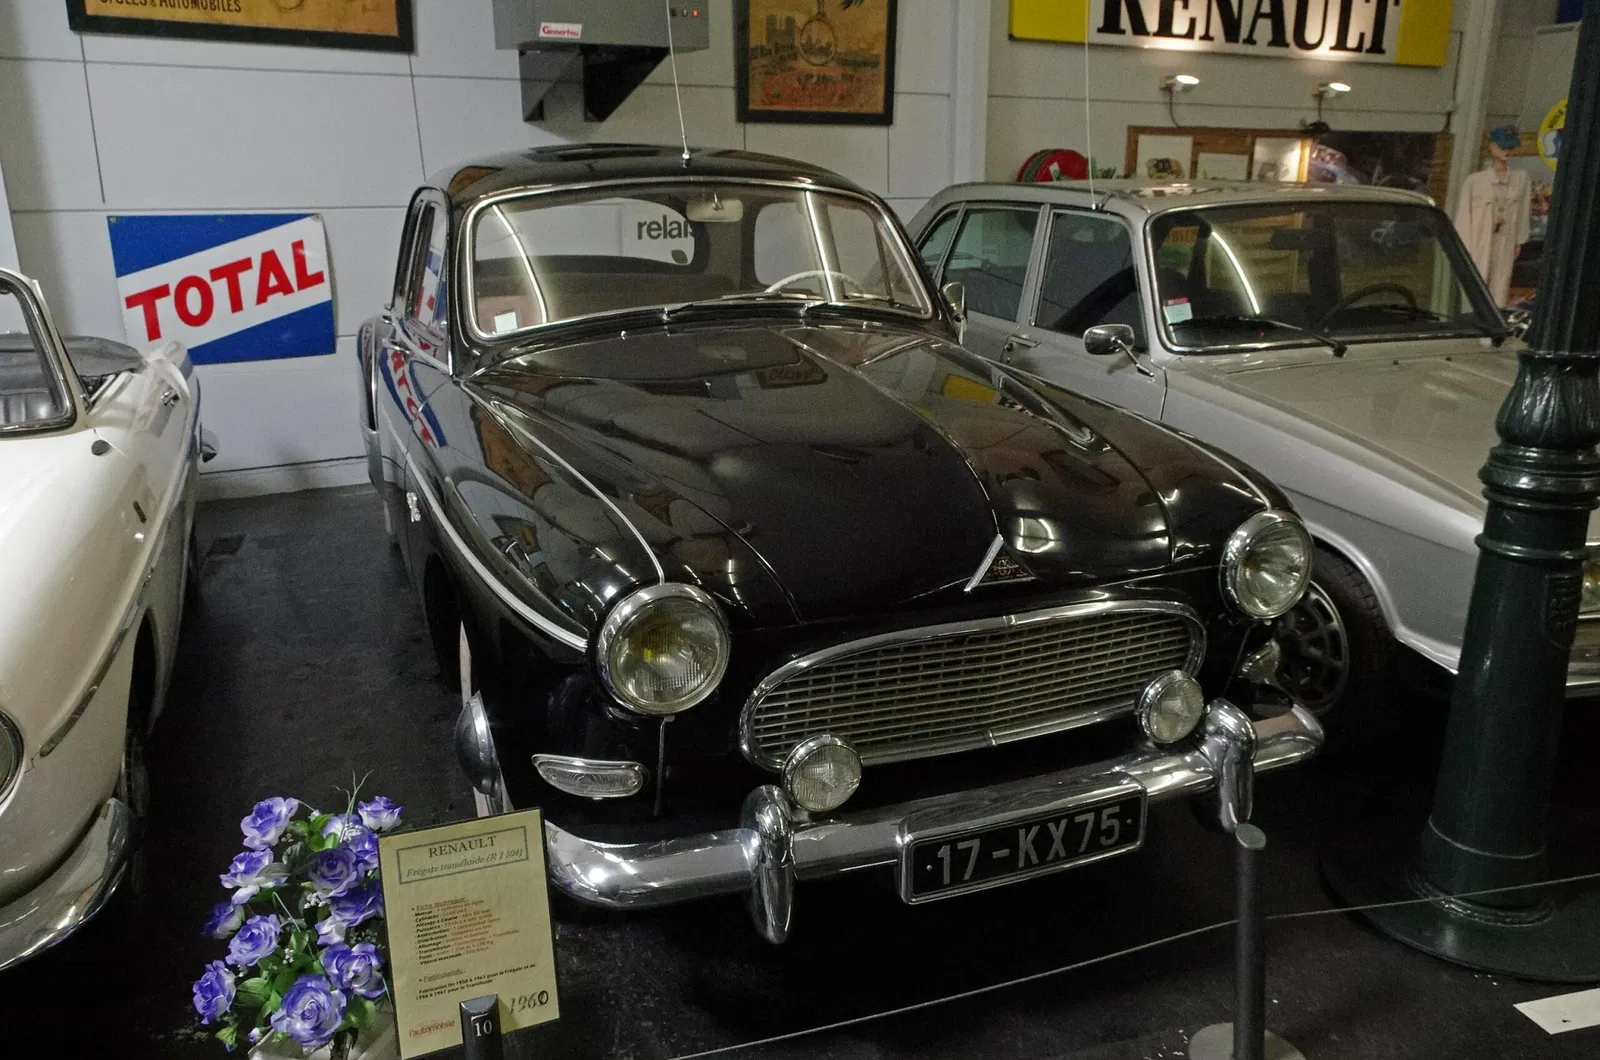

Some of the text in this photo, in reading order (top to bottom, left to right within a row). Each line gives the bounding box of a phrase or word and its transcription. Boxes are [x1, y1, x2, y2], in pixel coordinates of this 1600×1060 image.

[159, 0, 242, 12] AUTOMOBILES
[1096, 0, 1400, 54] RENAULT
[124, 239, 325, 342] TOTAL
[428, 835, 497, 858] RENAULT
[405, 864, 439, 878] Frégate
[508, 990, 549, 1015] 1960
[474, 1019, 493, 1037] 10
